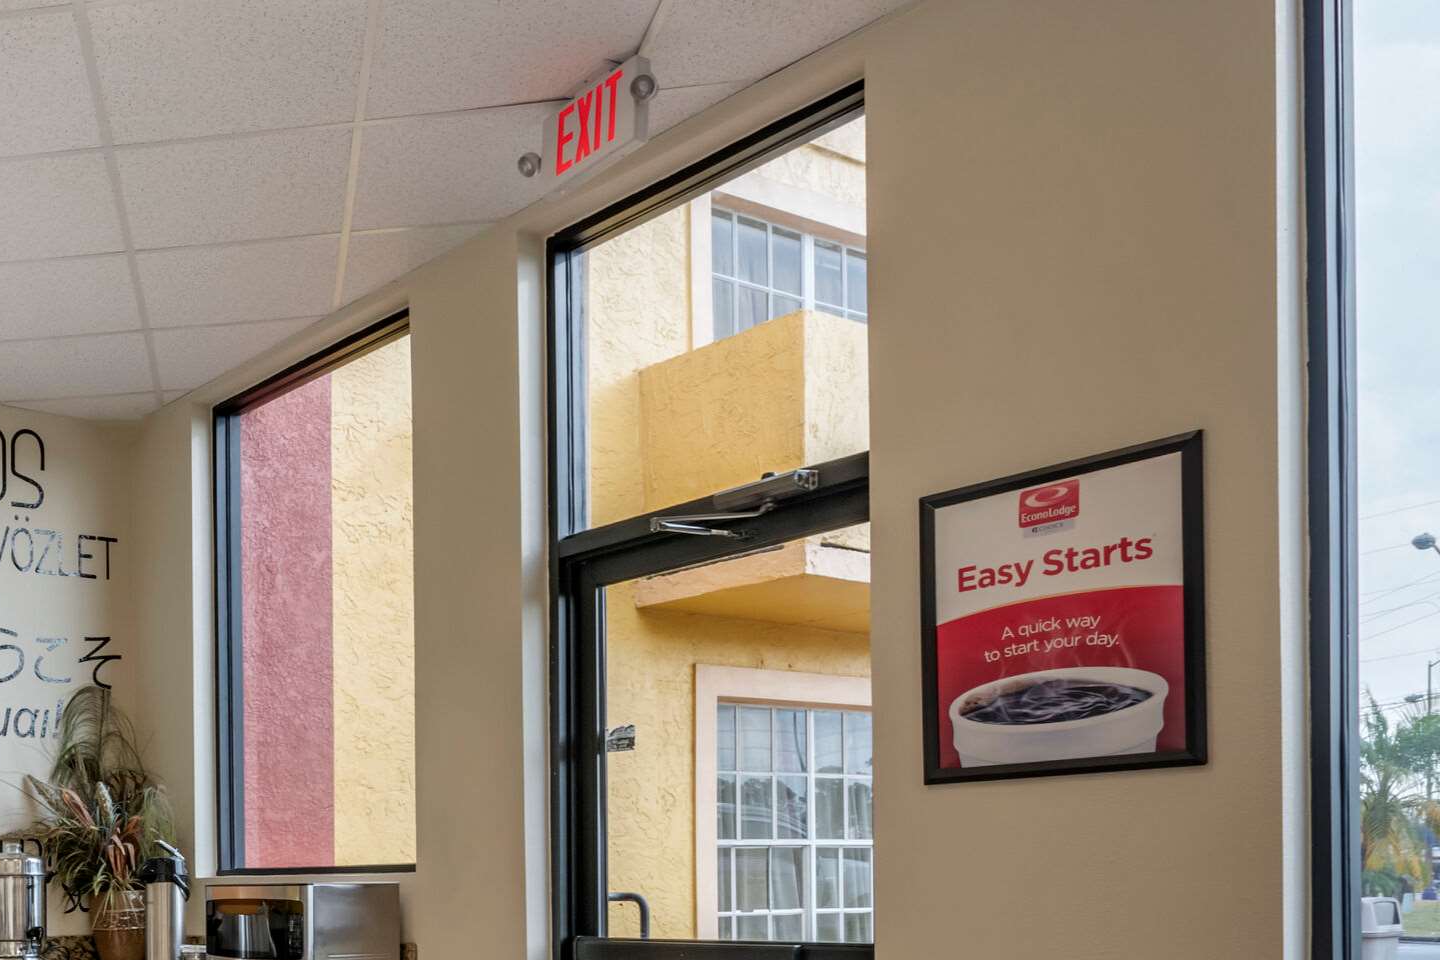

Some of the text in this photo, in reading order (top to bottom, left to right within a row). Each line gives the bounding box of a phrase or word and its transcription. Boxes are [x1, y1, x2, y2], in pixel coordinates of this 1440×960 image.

[556, 69, 624, 176] EXIT
[957, 536, 1153, 593] Easy Starts
[984, 631, 1120, 663] to start your day.
[1001, 615, 1101, 641] A quick way
